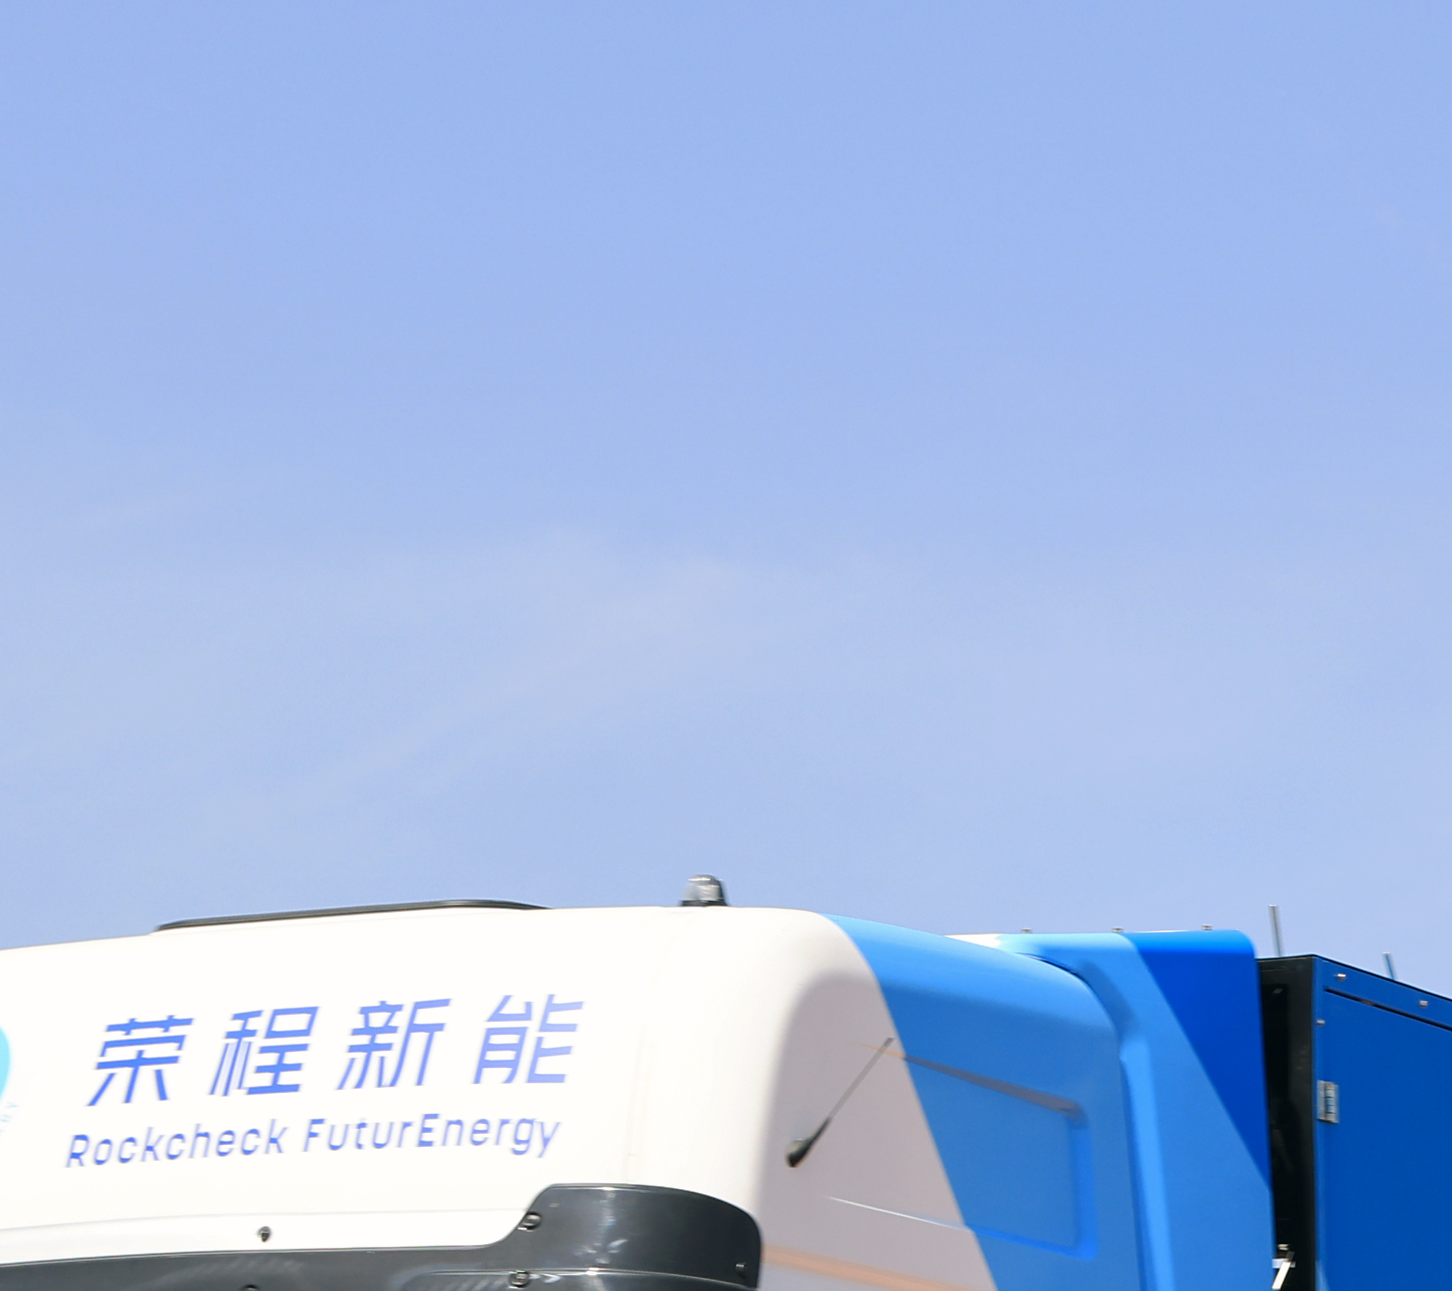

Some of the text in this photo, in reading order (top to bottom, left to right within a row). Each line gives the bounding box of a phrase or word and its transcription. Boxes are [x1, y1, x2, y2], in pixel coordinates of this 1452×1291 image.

[85, 993, 585, 1107] 荣程新能
[65, 1118, 289, 1168] Rockcheck
[302, 1112, 562, 1159] FuturEnergy
